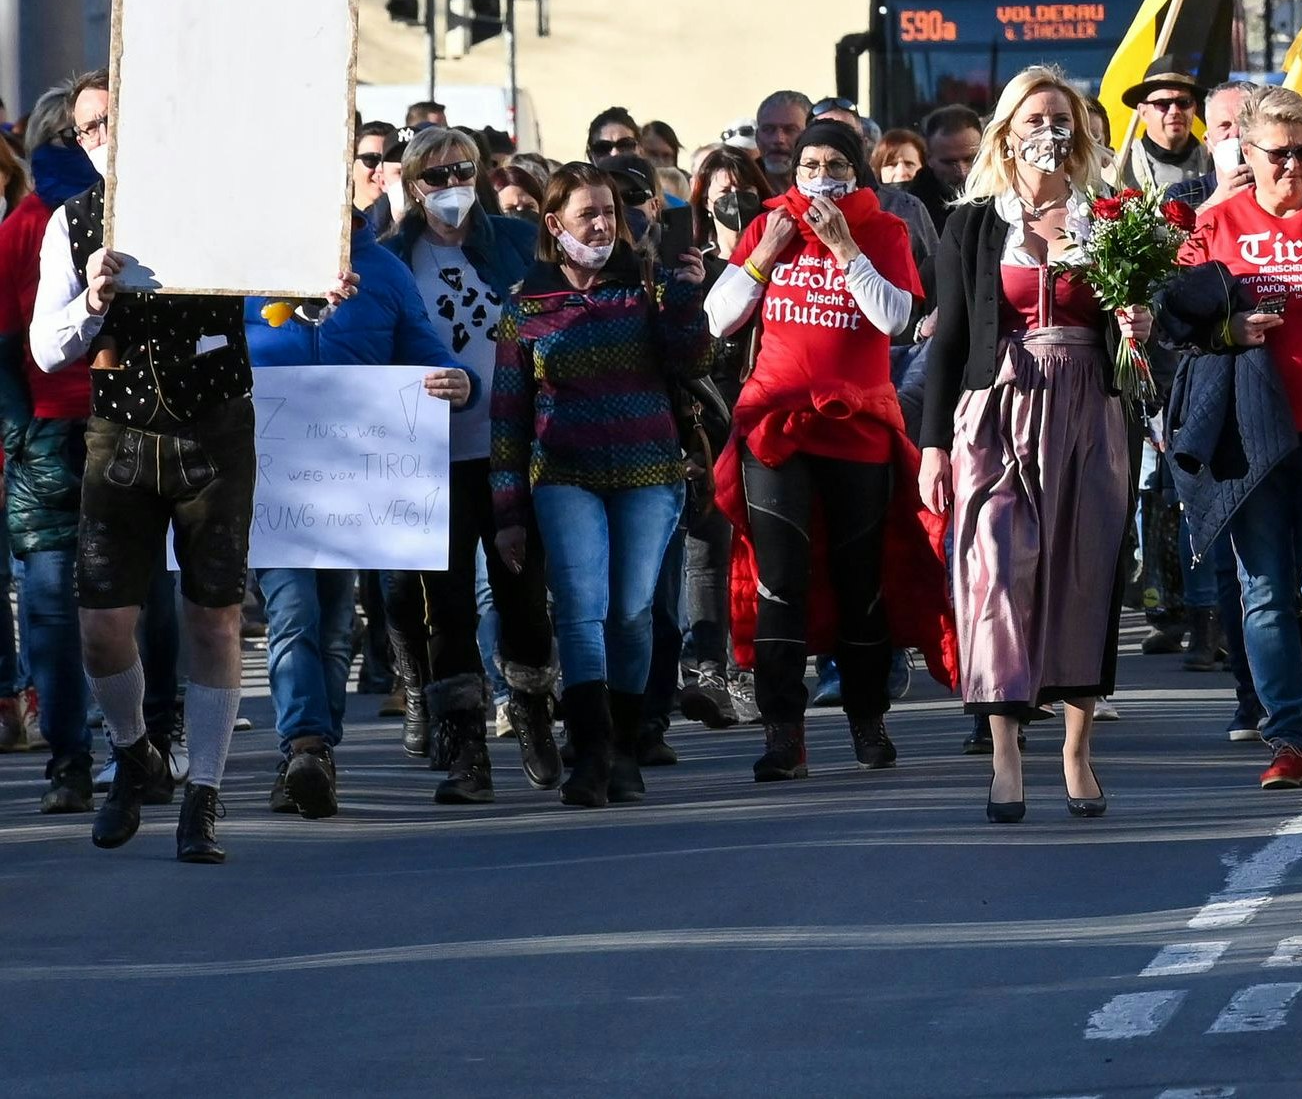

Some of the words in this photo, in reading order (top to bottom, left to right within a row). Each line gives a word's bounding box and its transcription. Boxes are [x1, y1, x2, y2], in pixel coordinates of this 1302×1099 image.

[770, 263, 852, 292] Tirole
[1257, 282, 1286, 293] DAFÜR
[806, 290, 844, 306] bischt
[848, 298, 855, 308] a
[765, 296, 861, 330] Mutant
[306, 424, 348, 438] MUSS
[357, 425, 387, 438] WEG
[288, 470, 324, 482] WEG
[330, 471, 356, 481] VON
[326, 513, 363, 527] MUSS
